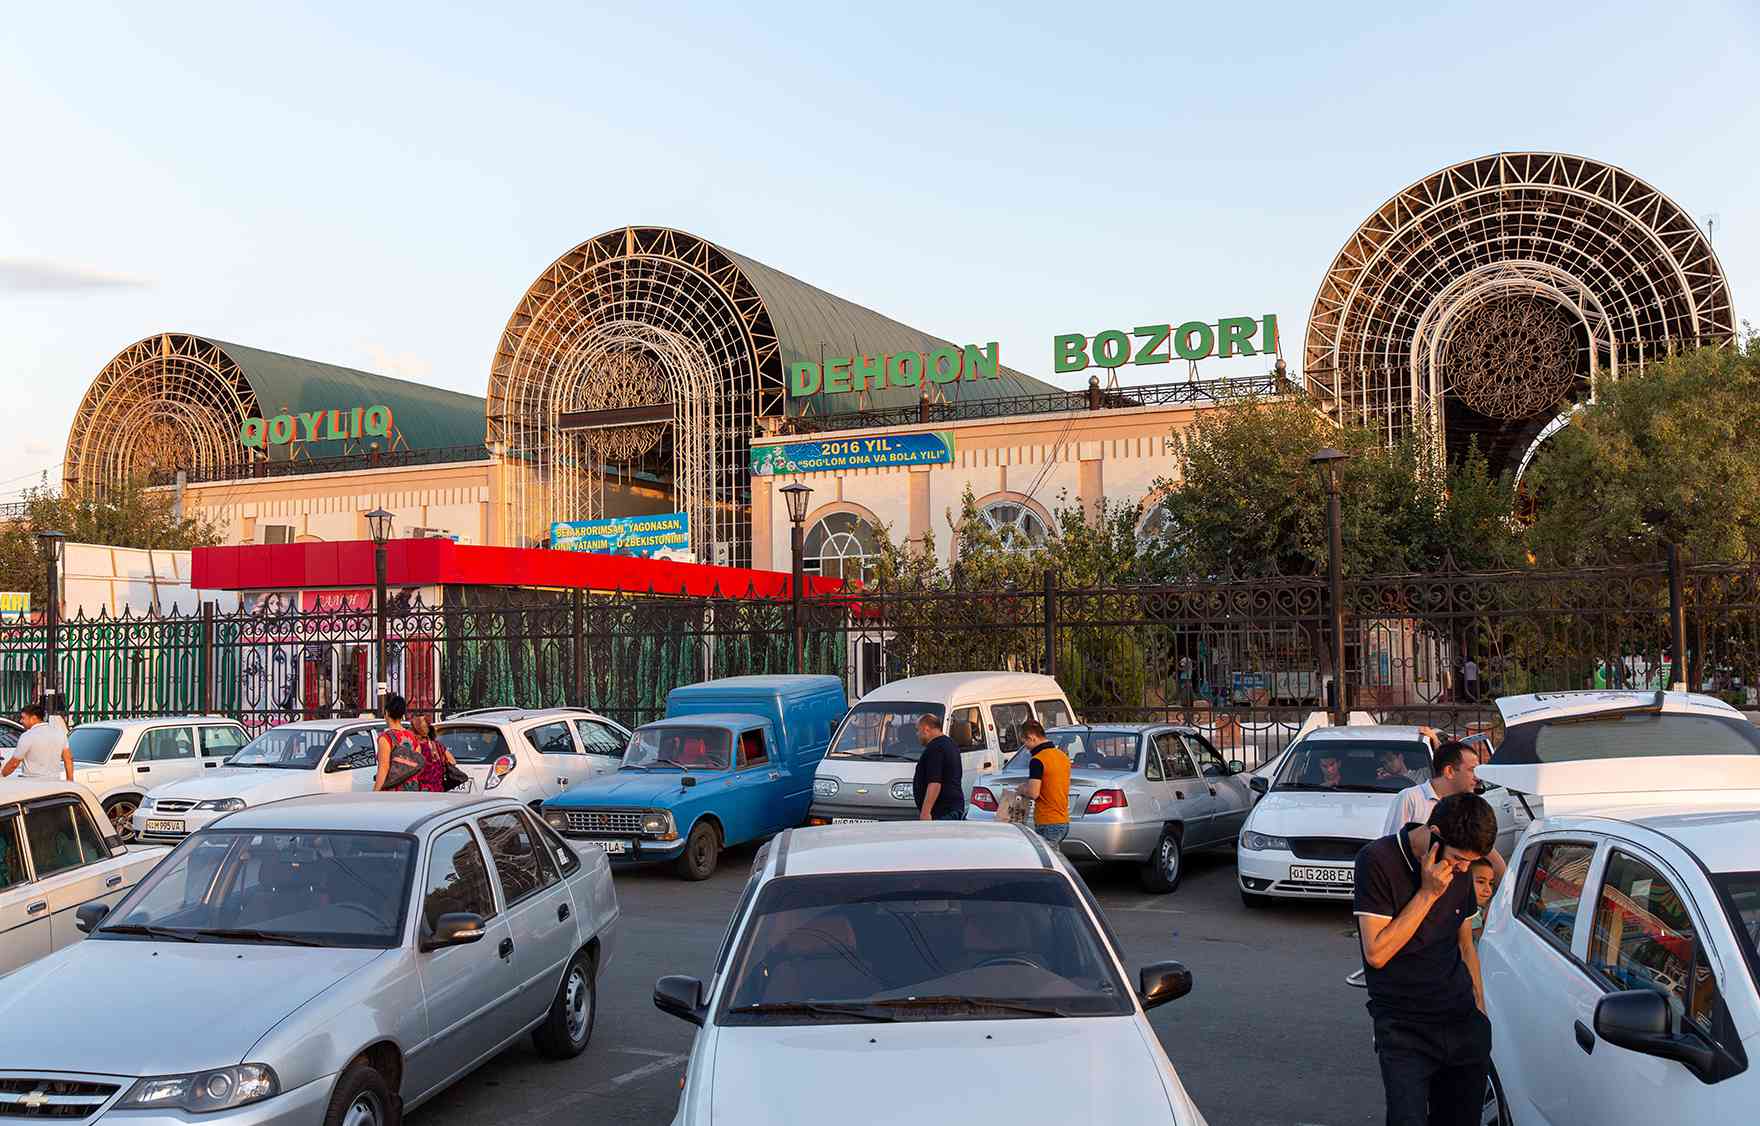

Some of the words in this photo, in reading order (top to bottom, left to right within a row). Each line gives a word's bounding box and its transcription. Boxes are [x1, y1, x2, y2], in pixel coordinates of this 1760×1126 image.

[1054, 314, 1278, 373] BOZORI
[791, 341, 999, 398] DEHQON
[821, 441, 860, 456] 2016
[864, 439, 892, 453] YIL
[849, 456, 871, 465] ONA
[873, 454, 887, 463] VA
[889, 452, 917, 462] BOLA
